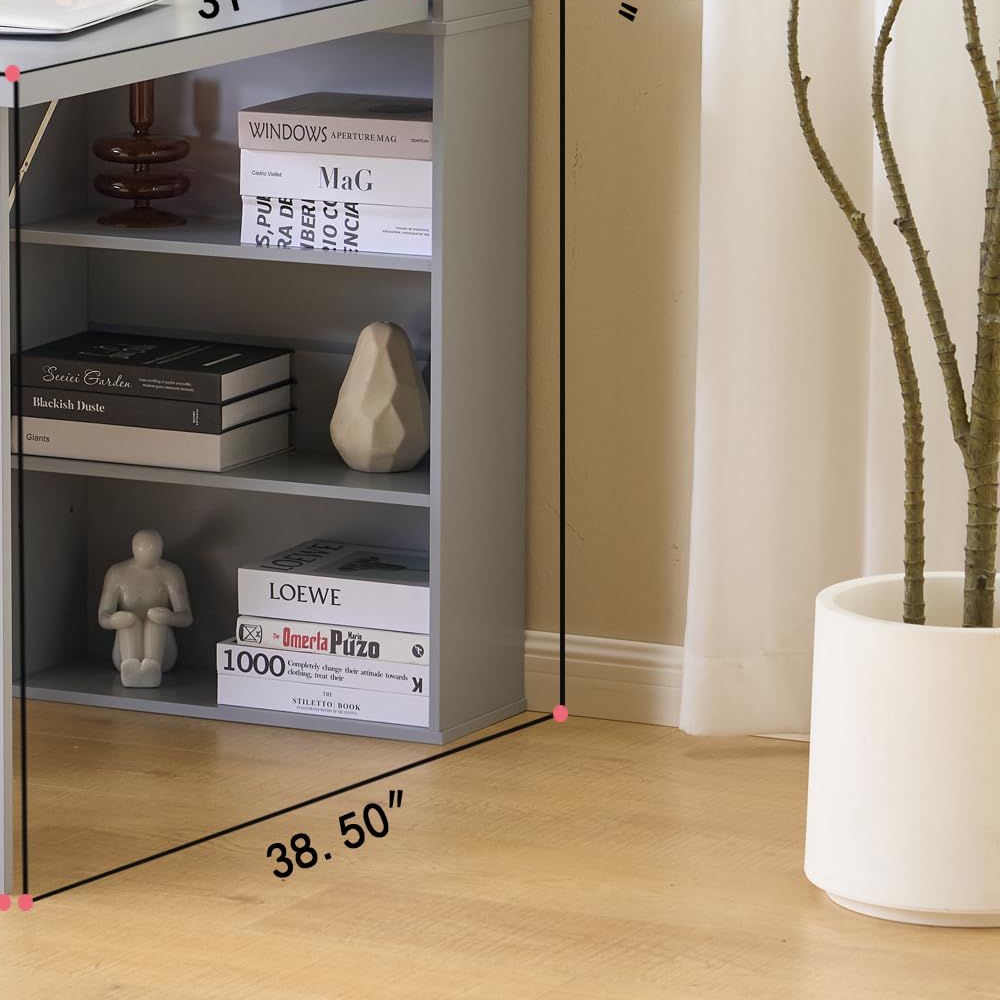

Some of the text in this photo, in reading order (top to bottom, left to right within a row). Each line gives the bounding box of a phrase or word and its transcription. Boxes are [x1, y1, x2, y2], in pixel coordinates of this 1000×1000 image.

[248, 121, 327, 143] WINDOWS
[331, 131, 375, 142] APERTURE
[376, 133, 397, 143] MAG
[319, 166, 373, 191] MaG
[83, 369, 131, 388] Garden
[33, 396, 74, 410] Blackish
[26, 433, 50, 442] Giants
[259, 543, 345, 571] LOEWE
[269, 582, 341, 606] LOEWE
[282, 626, 328, 651] Omerta
[329, 629, 380, 659] Puzo
[347, 631, 362, 640] Mario
[223, 649, 286, 677] 1000
[287, 660, 408, 681] Completely change their attitude towards
[330, 673, 344, 681] their
[292, 698, 333, 708] STILETTO
[338, 702, 361, 711] BOOK
